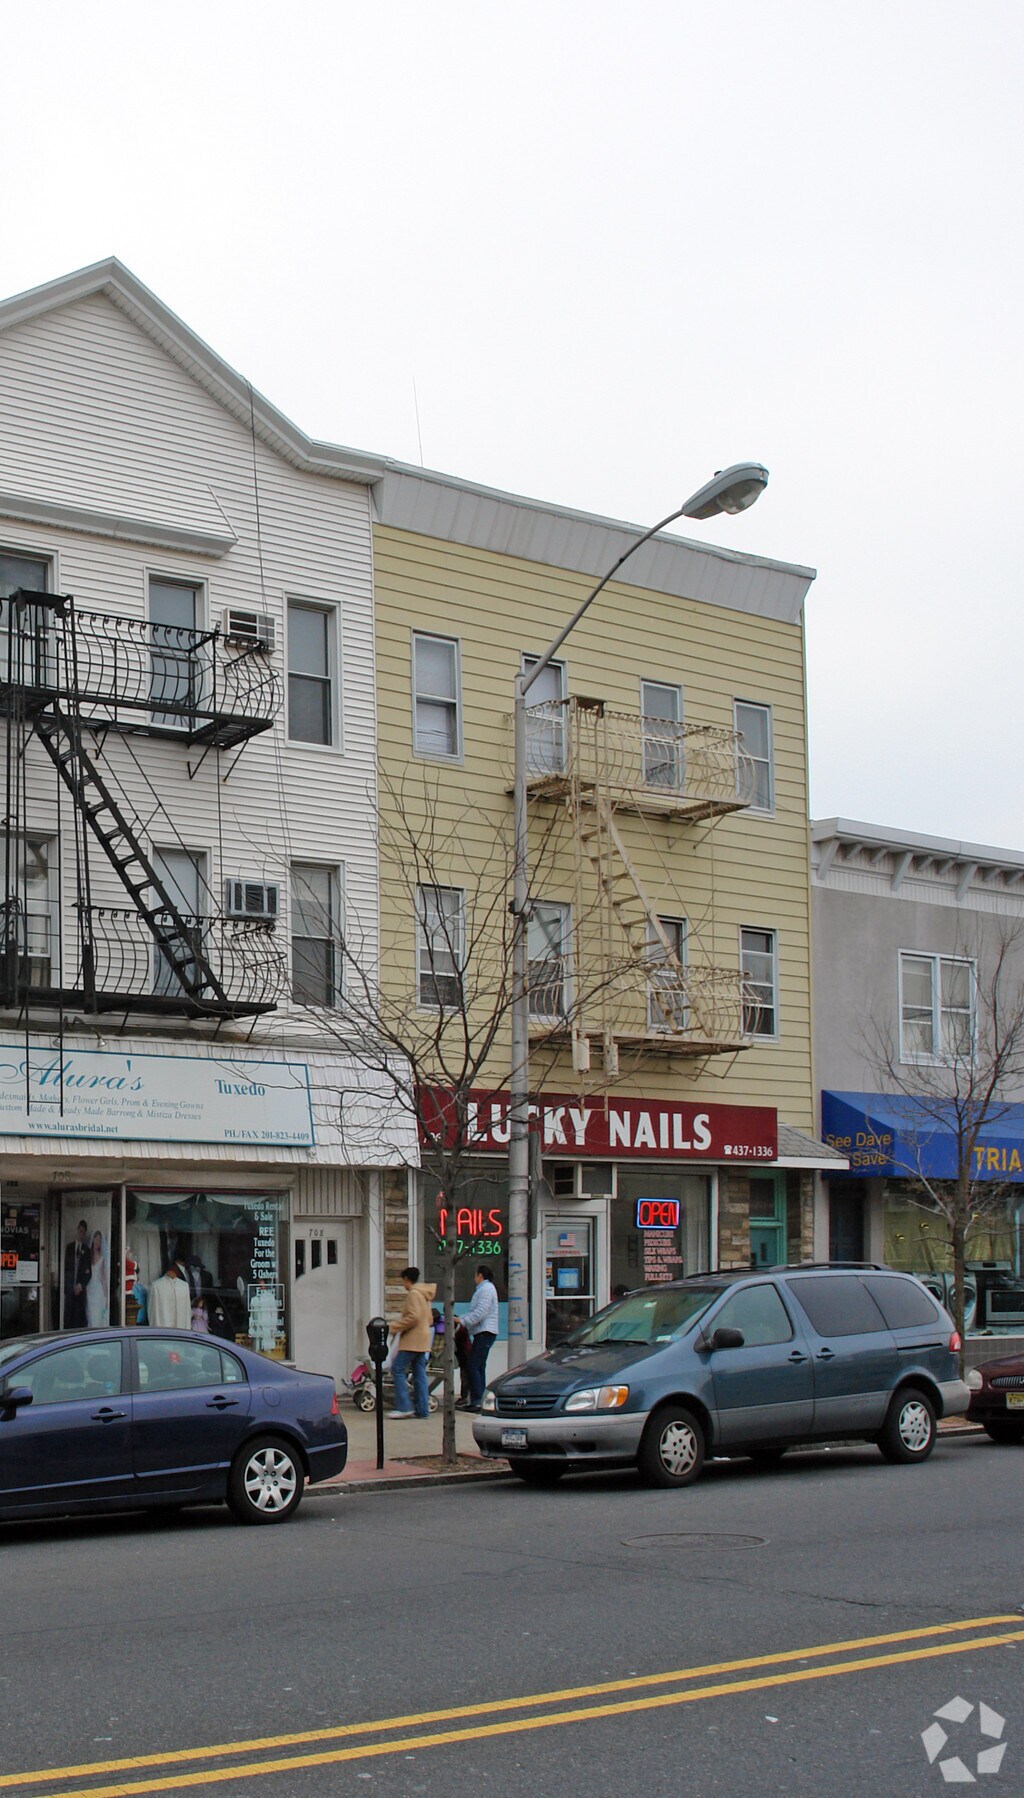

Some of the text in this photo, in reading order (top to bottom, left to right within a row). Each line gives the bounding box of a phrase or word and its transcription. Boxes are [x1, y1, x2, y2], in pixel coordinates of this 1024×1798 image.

[214, 1079, 266, 1097] Tuxedo
[72, 1095, 98, 1105] Flower
[121, 1098, 140, 1107] Prom
[142, 1099, 149, 1107] &
[151, 1099, 179, 1110] Evening
[180, 1101, 204, 1110] Gowns
[48, 1105, 55, 1113] &
[84, 1106, 104, 1115] Made
[137, 1109, 143, 1117] &
[175, 1111, 202, 1120] Dresses
[28, 1122, 118, 1133] www.alurasbridal.net
[609, 1110, 712, 1150] NAILS
[827, 1132, 891, 1147] See Dave
[852, 1152, 887, 1166] Save
[974, 1147, 1023, 1171] TRIA
[260, 1212, 273, 1221] Sale
[640, 1201, 679, 1227] OPEN
[254, 1238, 275, 1247] Tuxedo
[254, 1248, 275, 1258] For the
[250, 1259, 270, 1269] Groom
[253, 1270, 257, 1279] 5
